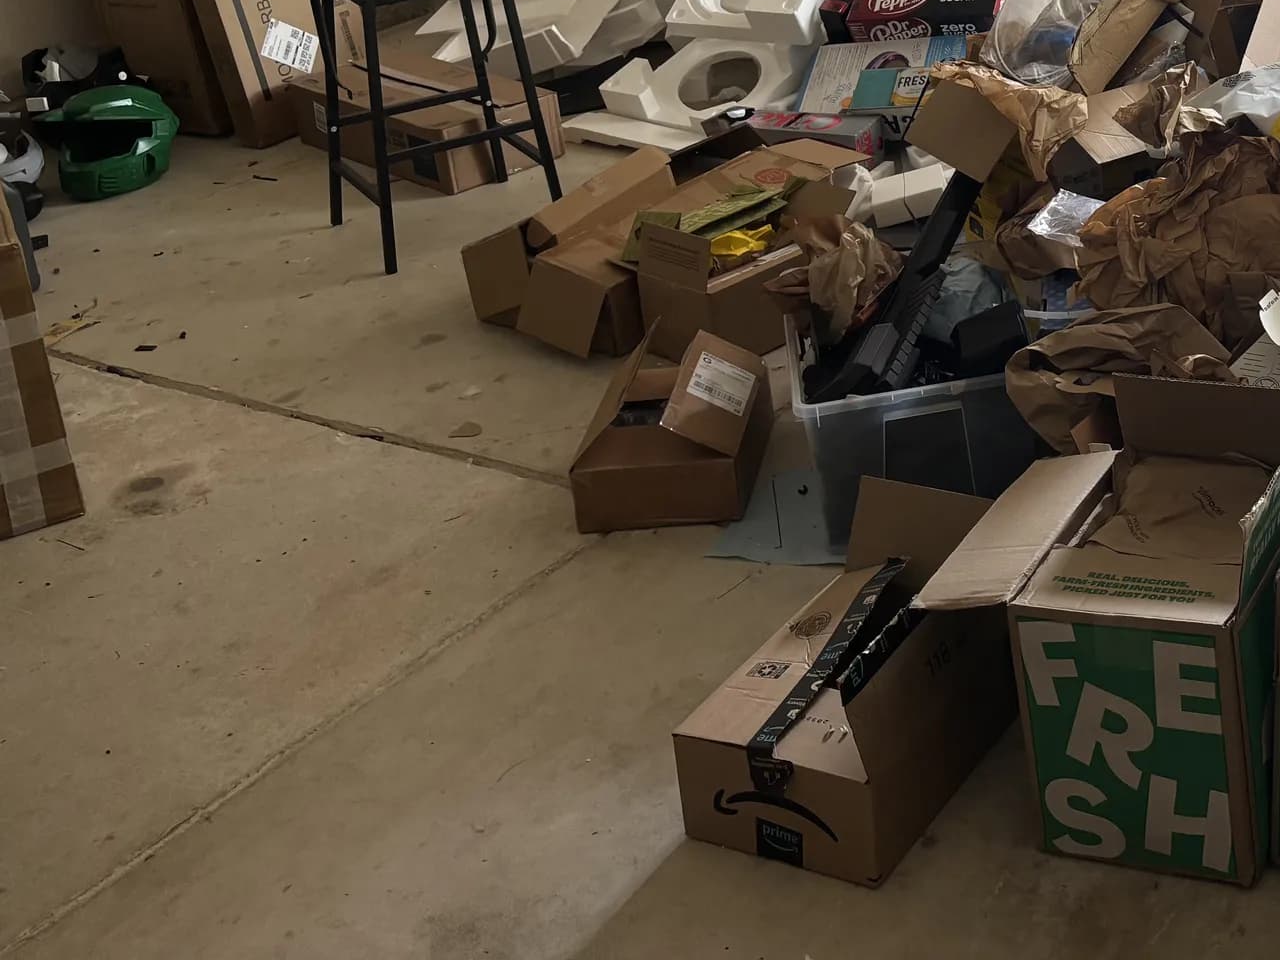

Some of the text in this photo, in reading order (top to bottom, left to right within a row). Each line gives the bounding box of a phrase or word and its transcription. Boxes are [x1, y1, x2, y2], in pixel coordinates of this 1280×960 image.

[887, 20, 976, 34] Dr zero
[762, 824, 799, 844] prime
